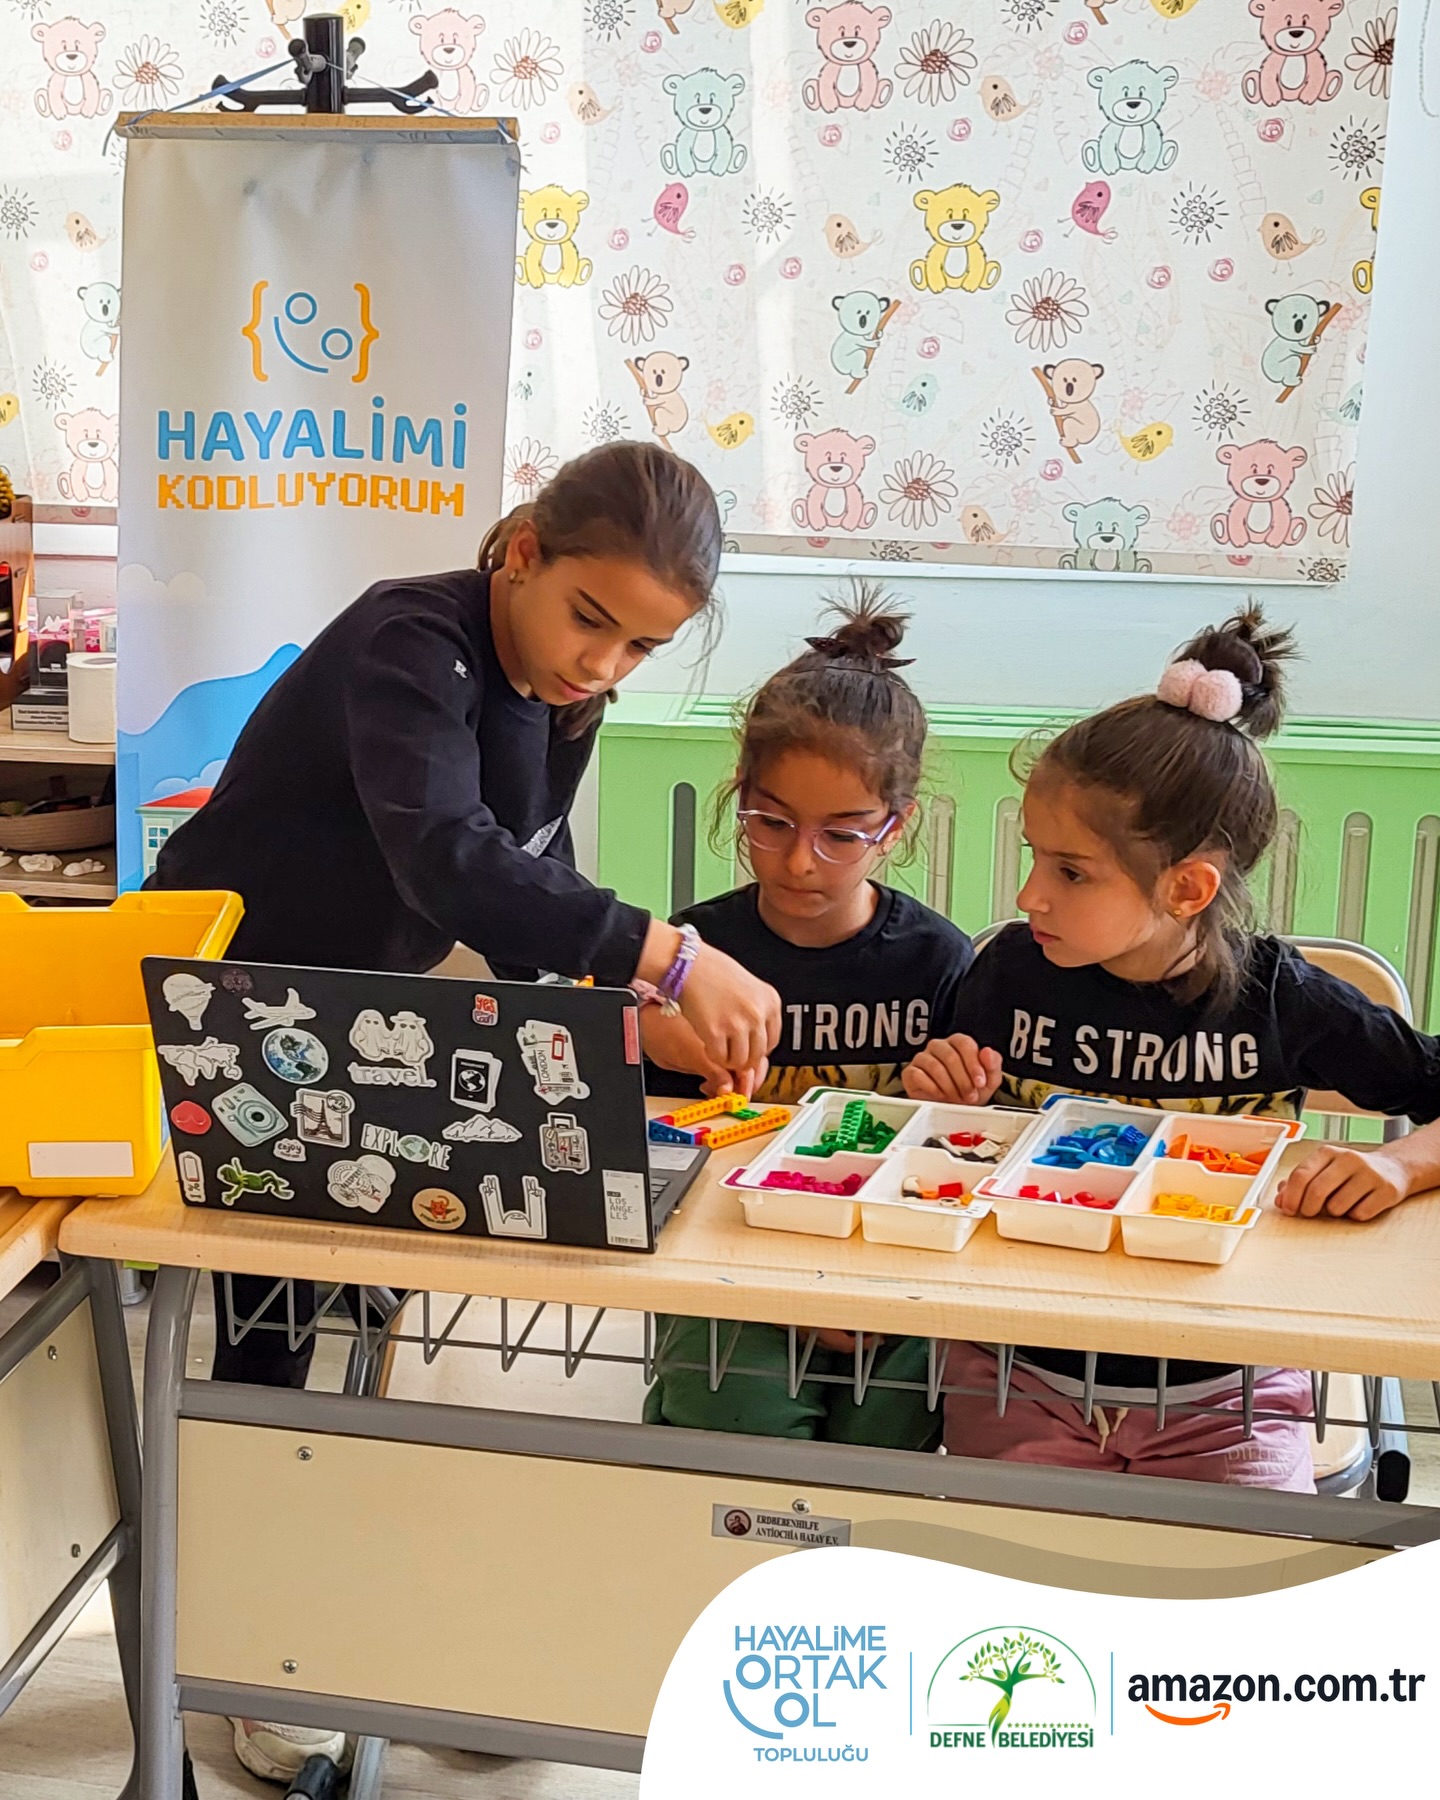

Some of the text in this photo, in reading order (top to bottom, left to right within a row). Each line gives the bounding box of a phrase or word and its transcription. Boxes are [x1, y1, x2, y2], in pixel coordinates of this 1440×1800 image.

[157, 396, 467, 469] HAYALİMİ
[158, 472, 465, 517] KODLUYORUM
[786, 998, 930, 1051] TRONG
[1009, 1008, 1259, 1082] BE STRONG
[537, 1049, 551, 1082] LONDON
[610, 1211, 628, 1221] LES
[799, 1532, 826, 1545] HATAY
